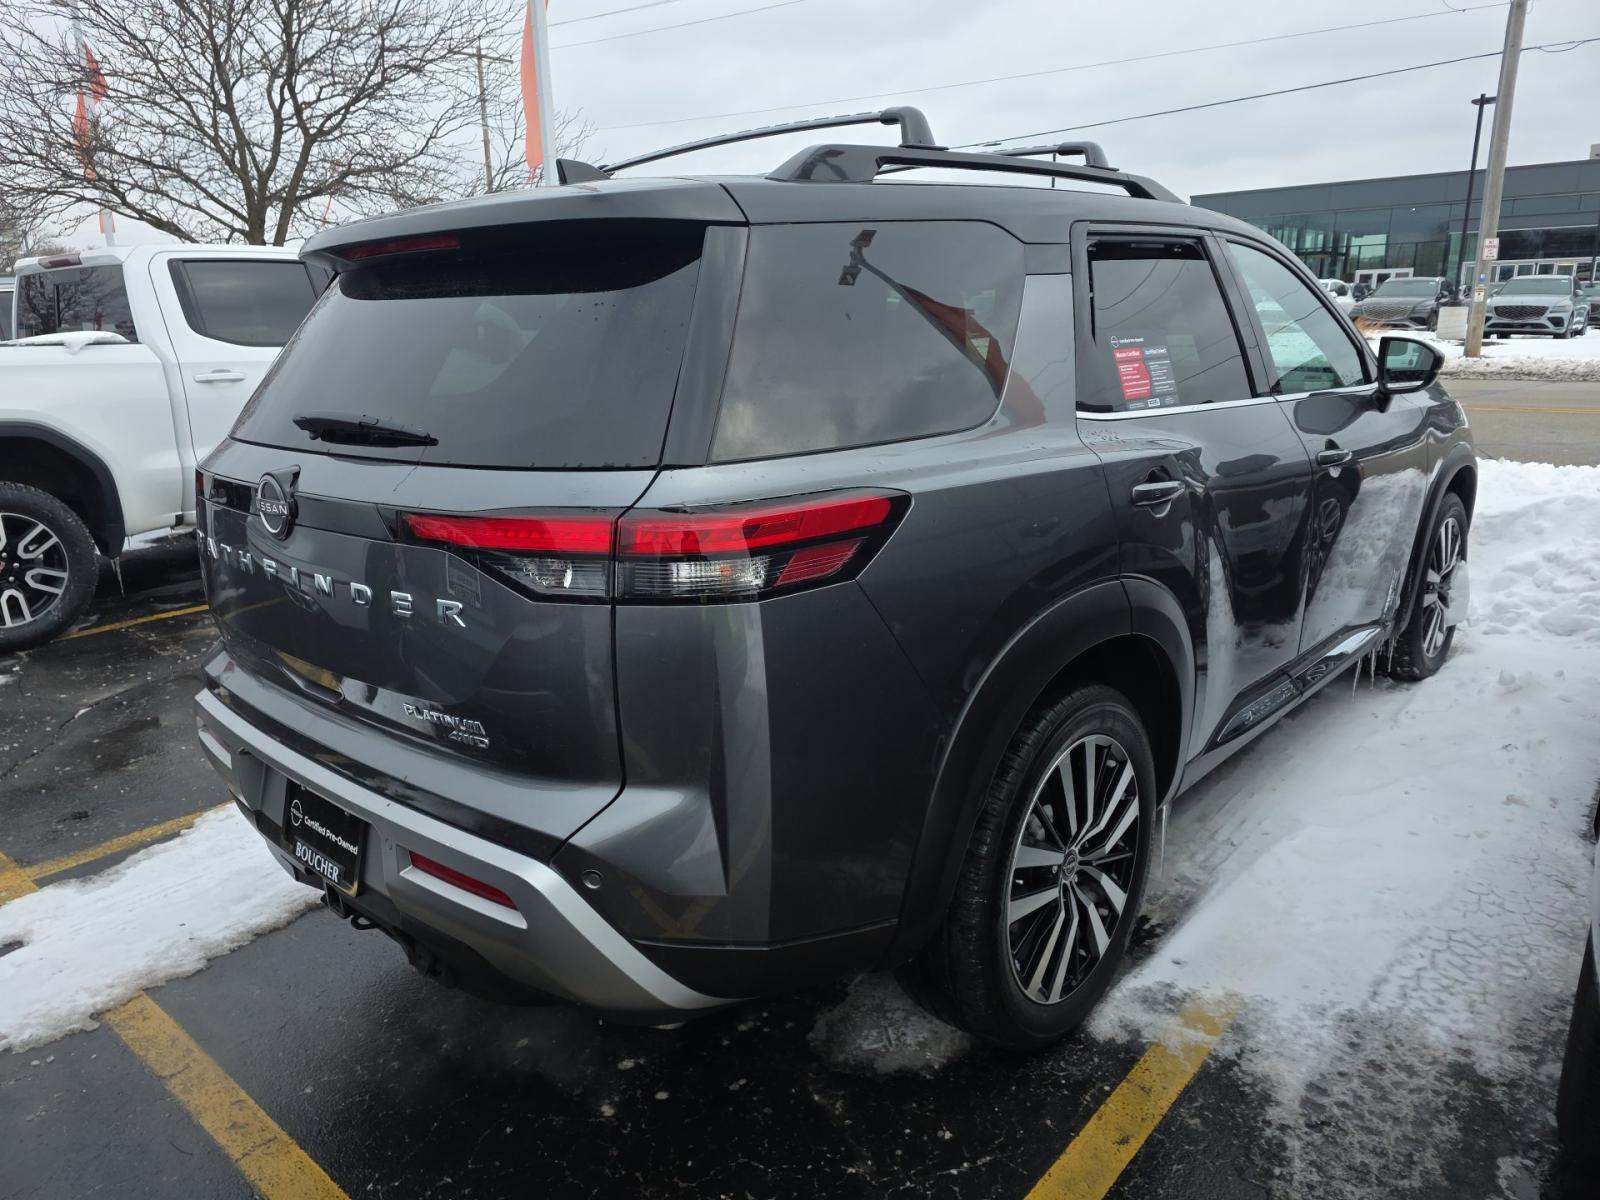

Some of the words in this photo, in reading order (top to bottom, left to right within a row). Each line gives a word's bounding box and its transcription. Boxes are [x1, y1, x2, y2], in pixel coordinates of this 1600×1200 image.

[304, 815, 326, 836] Certified
[325, 829, 359, 855] Pre-Owned
[295, 841, 339, 883] BOUCHER
